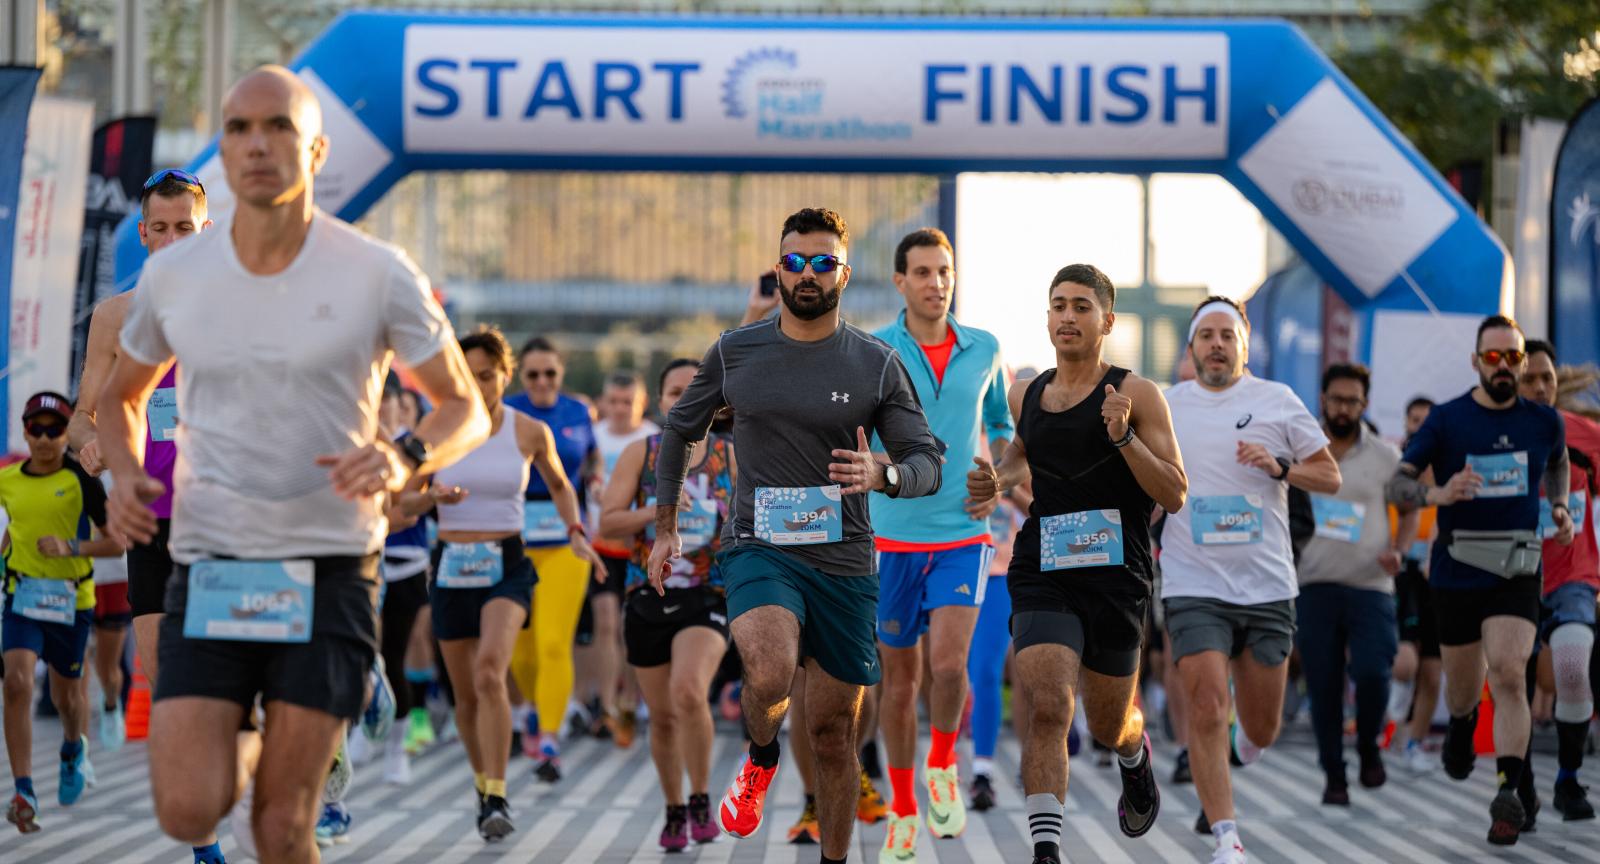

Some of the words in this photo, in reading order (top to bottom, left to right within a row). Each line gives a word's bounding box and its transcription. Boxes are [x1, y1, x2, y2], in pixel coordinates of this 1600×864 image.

[414, 58, 703, 121] START
[921, 63, 1219, 125] FINISH
[757, 90, 824, 115] Half
[757, 118, 913, 140] Marathon
[792, 511, 828, 523] 1394
[1074, 532, 1110, 545] 1359
